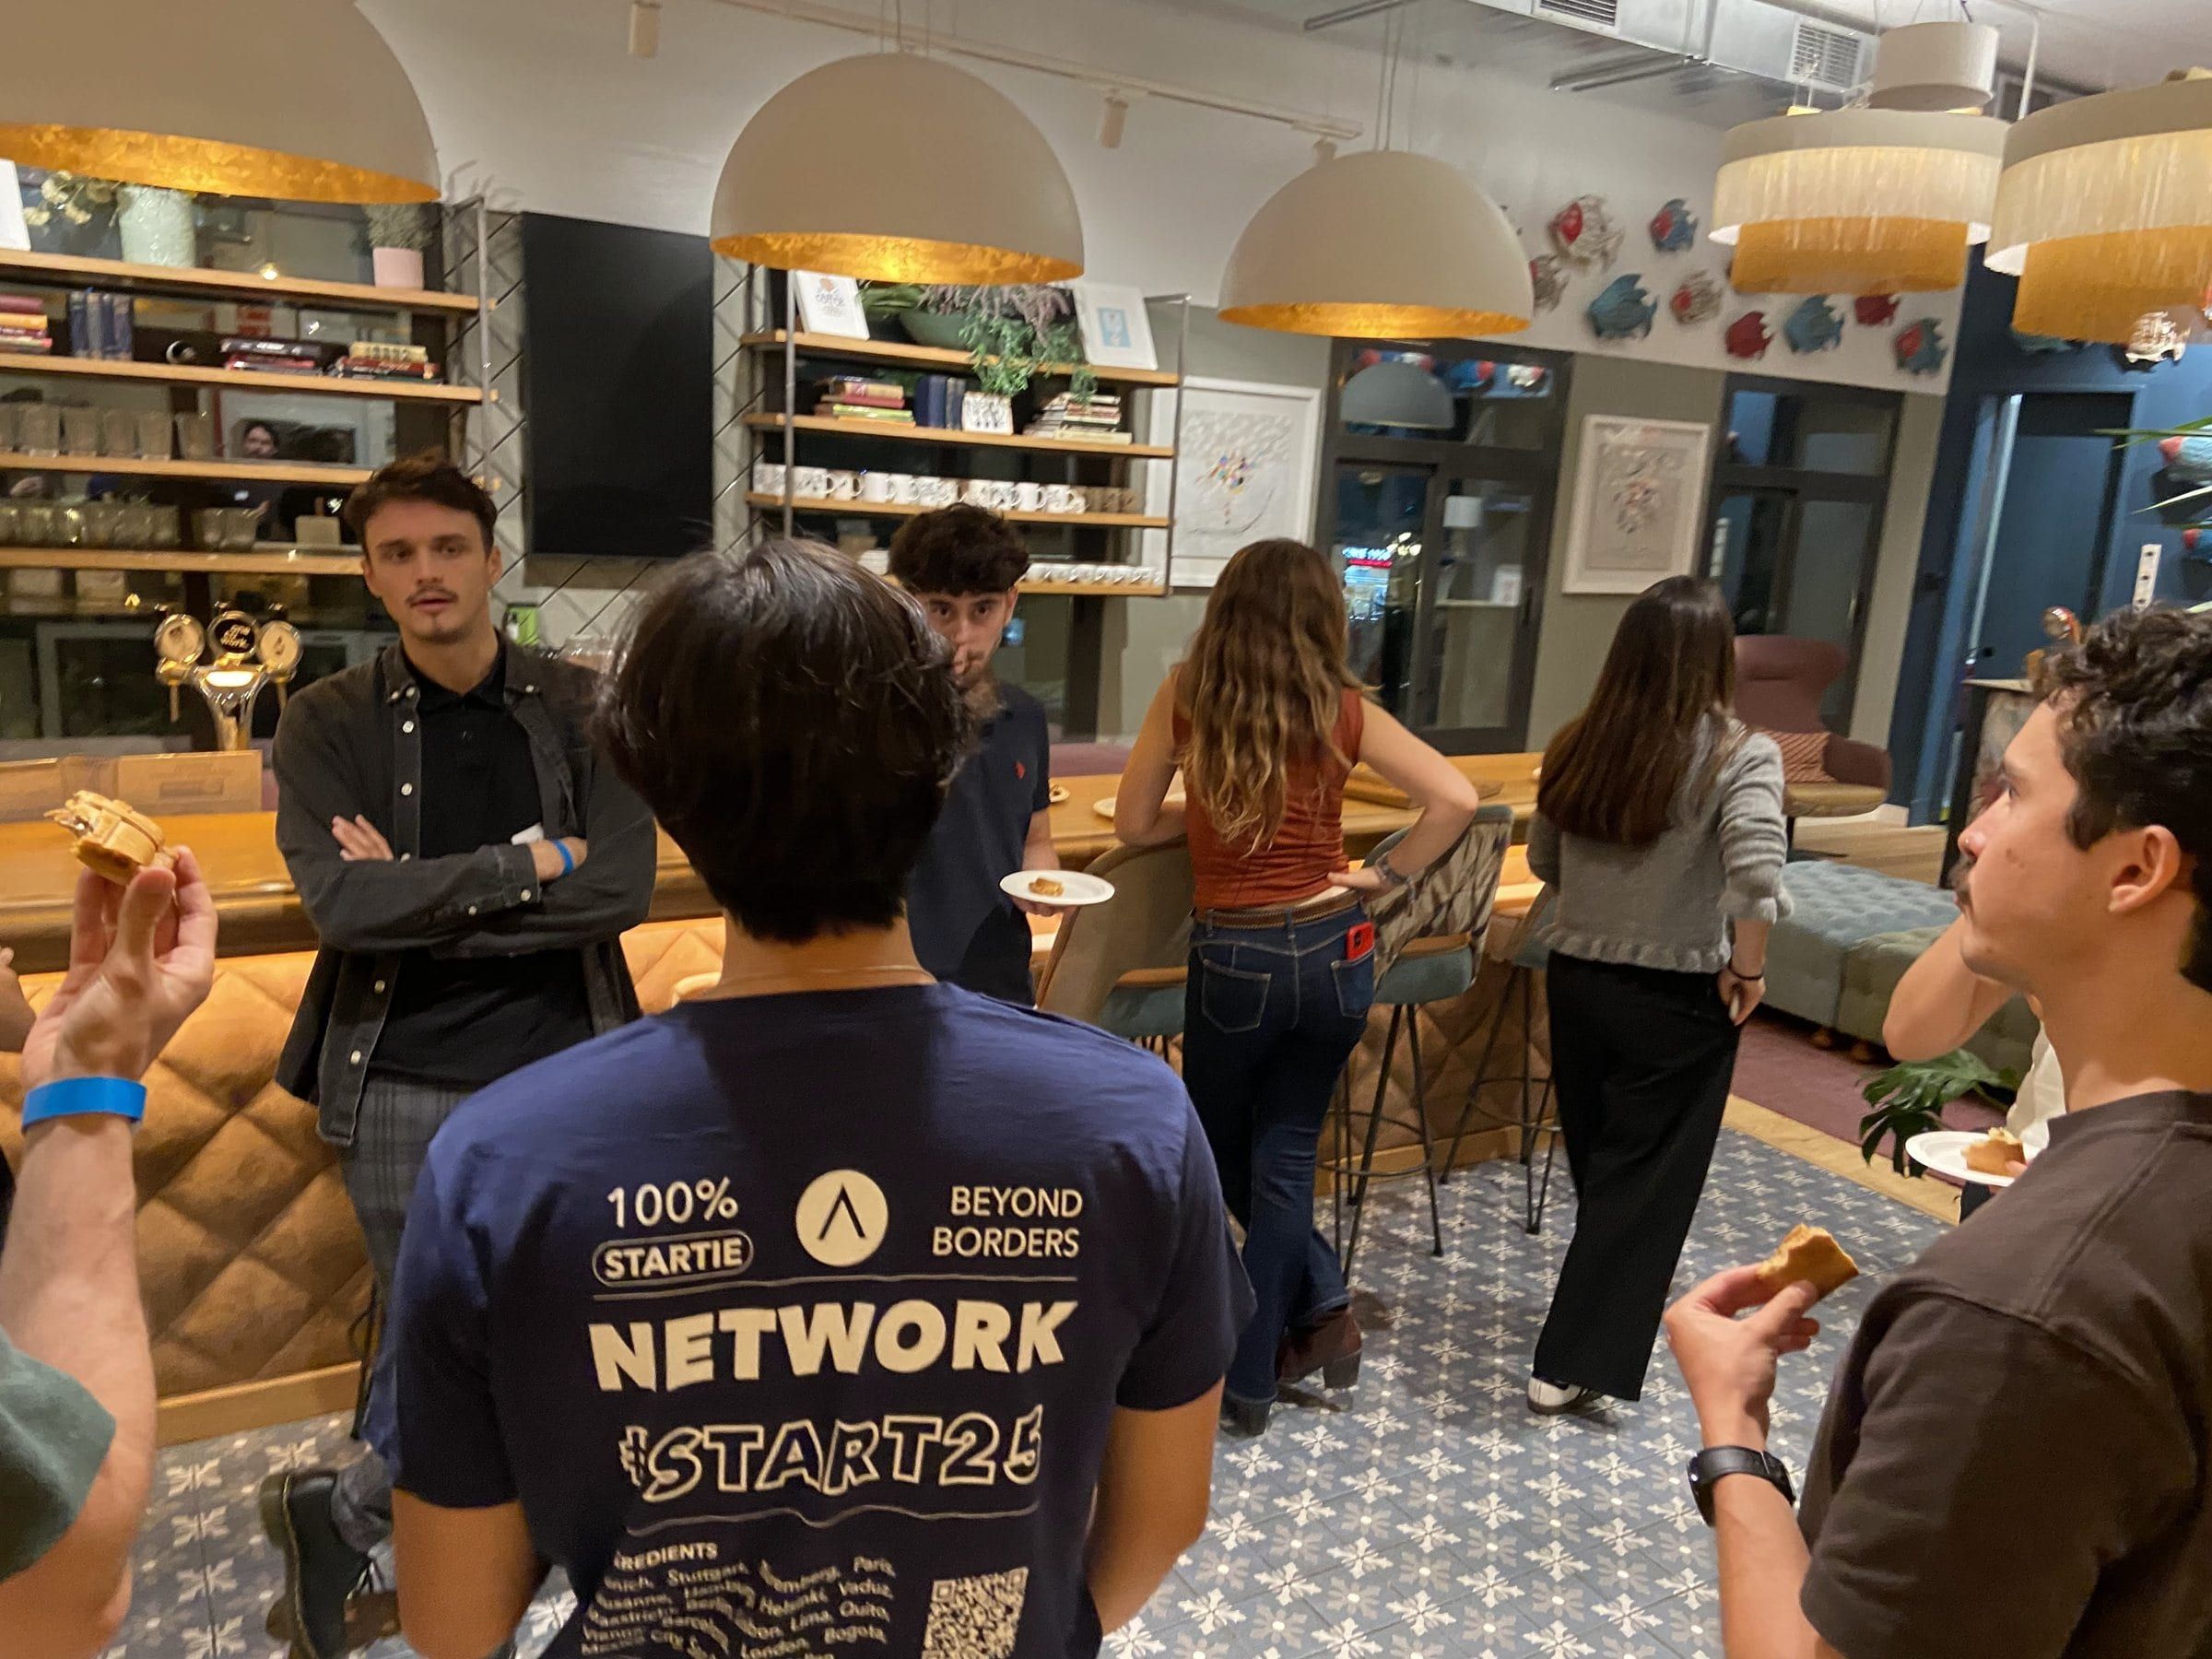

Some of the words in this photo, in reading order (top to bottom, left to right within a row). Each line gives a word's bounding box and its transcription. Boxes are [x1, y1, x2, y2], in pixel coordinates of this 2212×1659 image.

[606, 1177, 738, 1229] 100%
[950, 1186, 1083, 1218] BEYOND
[604, 1237, 743, 1280] STARTIE
[933, 1227, 1080, 1258] BORDERS
[588, 1299, 1079, 1392] NETWORK
[614, 1543, 718, 1572] REDIENTS
